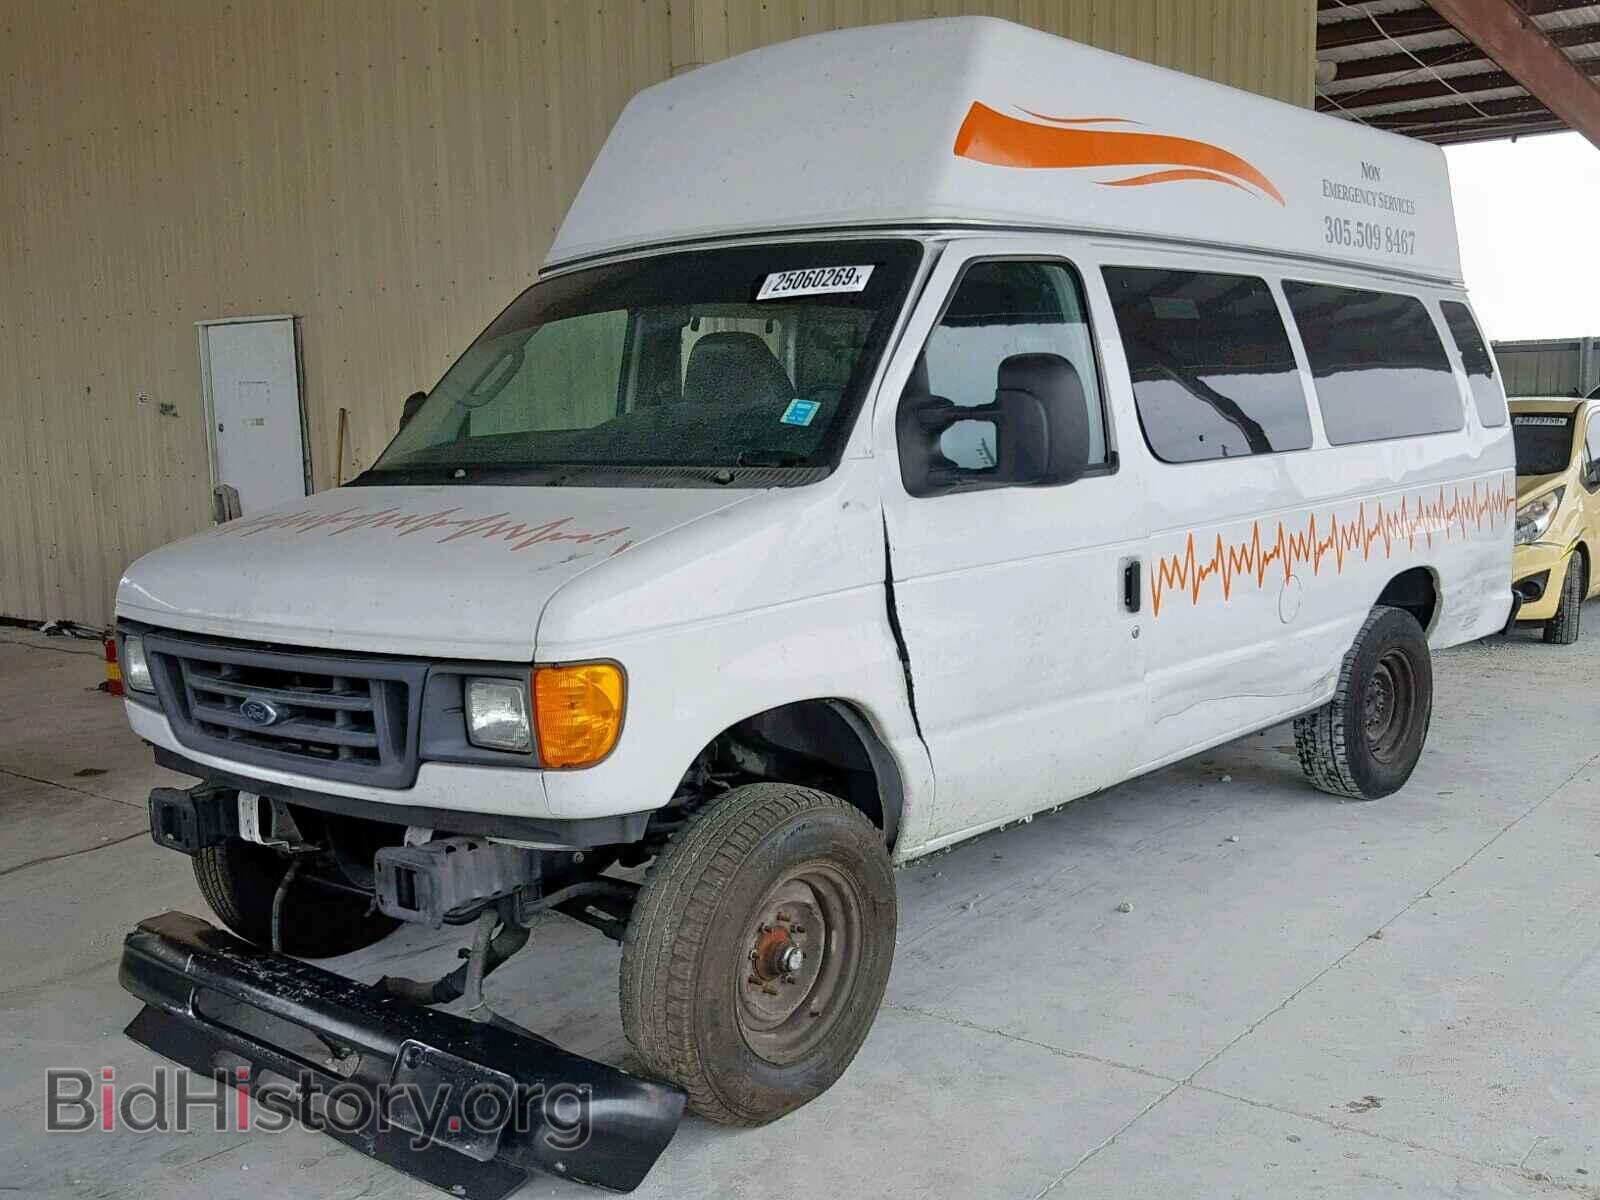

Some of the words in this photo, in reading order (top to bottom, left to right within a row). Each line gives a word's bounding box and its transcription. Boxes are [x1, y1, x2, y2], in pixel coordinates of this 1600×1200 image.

[1322, 179, 1376, 207] EMERGENCY
[1378, 192, 1416, 215] SERVICES
[1325, 215, 1381, 250] 305.509
[1385, 226, 1415, 255] 8467
